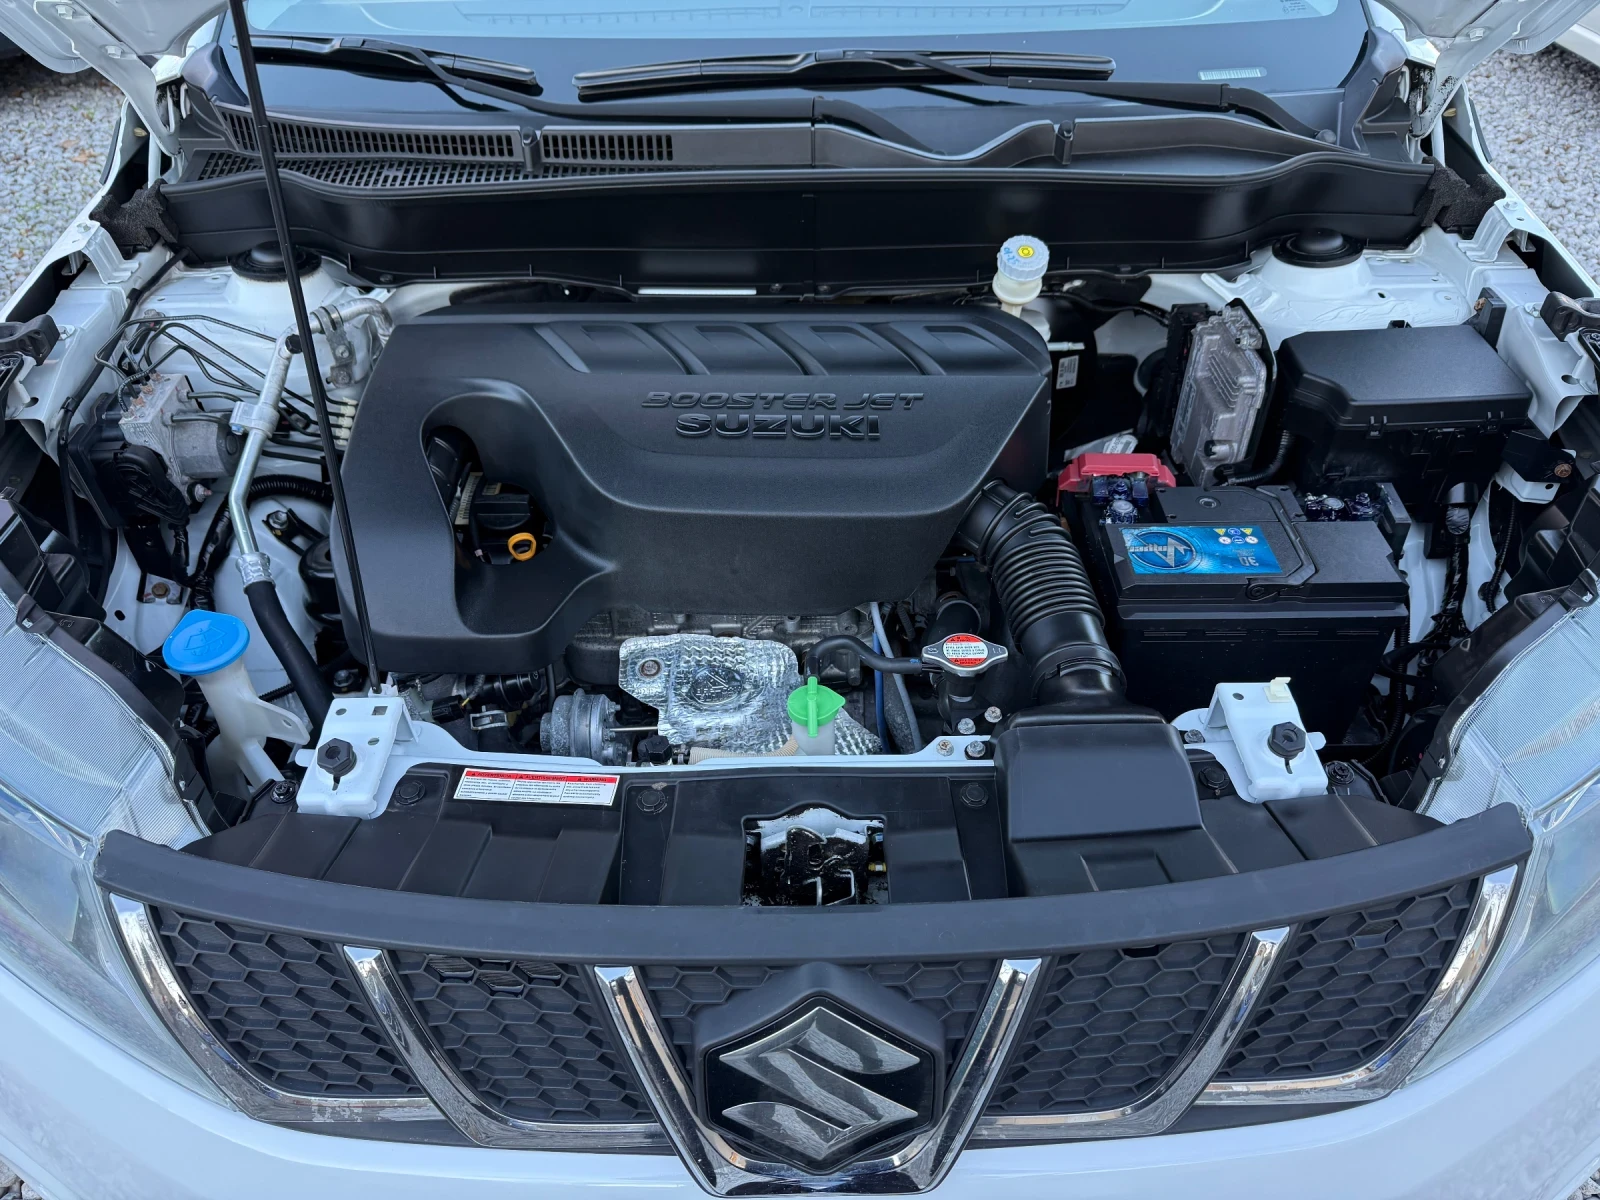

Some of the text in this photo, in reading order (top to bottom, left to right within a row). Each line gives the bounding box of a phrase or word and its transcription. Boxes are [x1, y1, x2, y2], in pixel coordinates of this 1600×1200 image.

[641, 391, 924, 410] BOOSTER JET
[675, 413, 881, 439] SUZUKI
